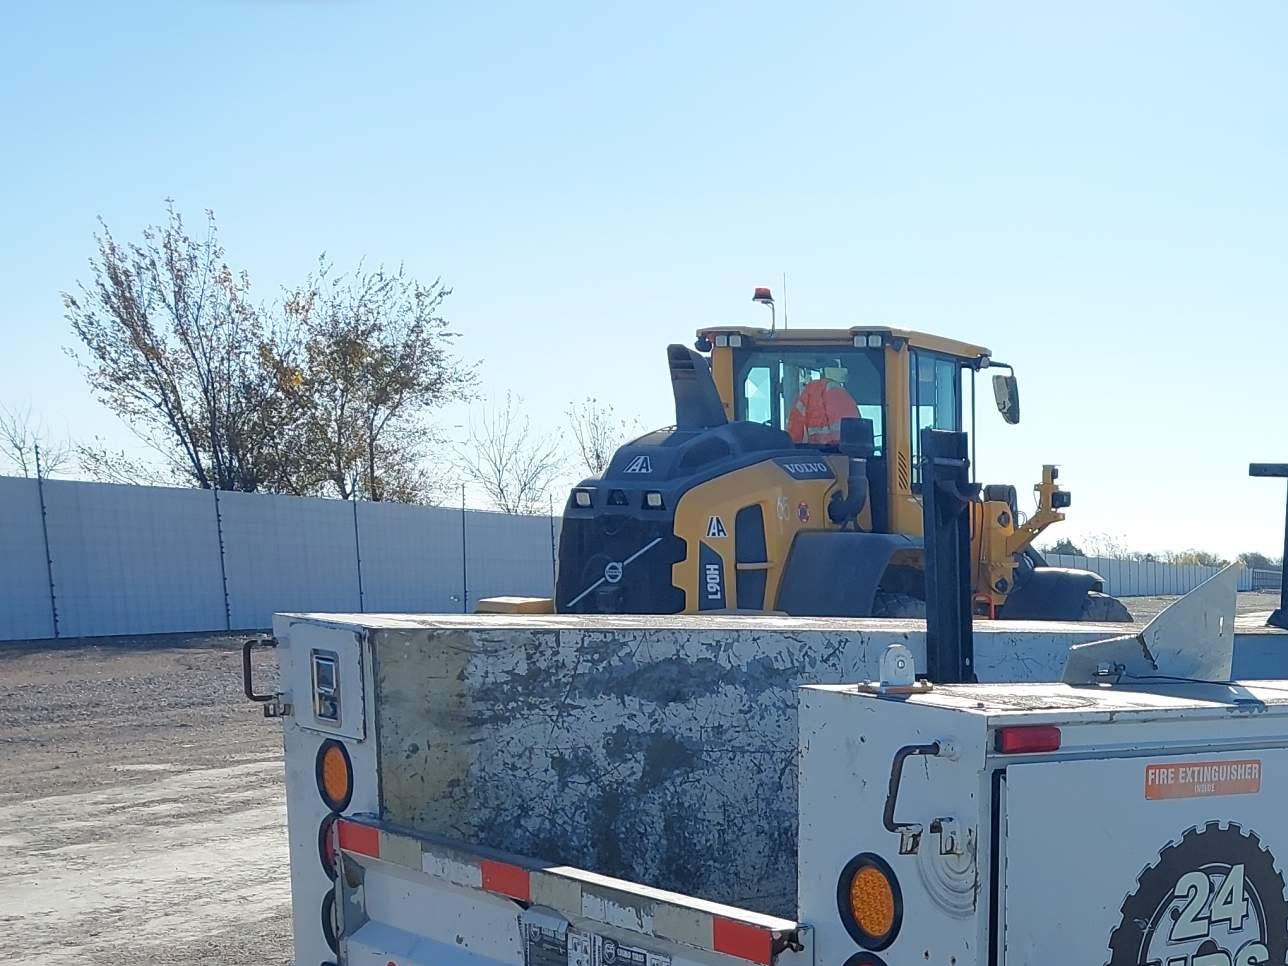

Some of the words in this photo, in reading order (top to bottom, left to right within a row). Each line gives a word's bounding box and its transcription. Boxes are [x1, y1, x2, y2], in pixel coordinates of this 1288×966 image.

[783, 463, 827, 473] VOLVO
[706, 564, 721, 599] L90H
[1148, 768, 1175, 785] FIRE
[1178, 763, 1259, 784] EXTINGUISHER
[1194, 783, 1215, 793] INSIDE
[1169, 864, 1249, 941] 24
